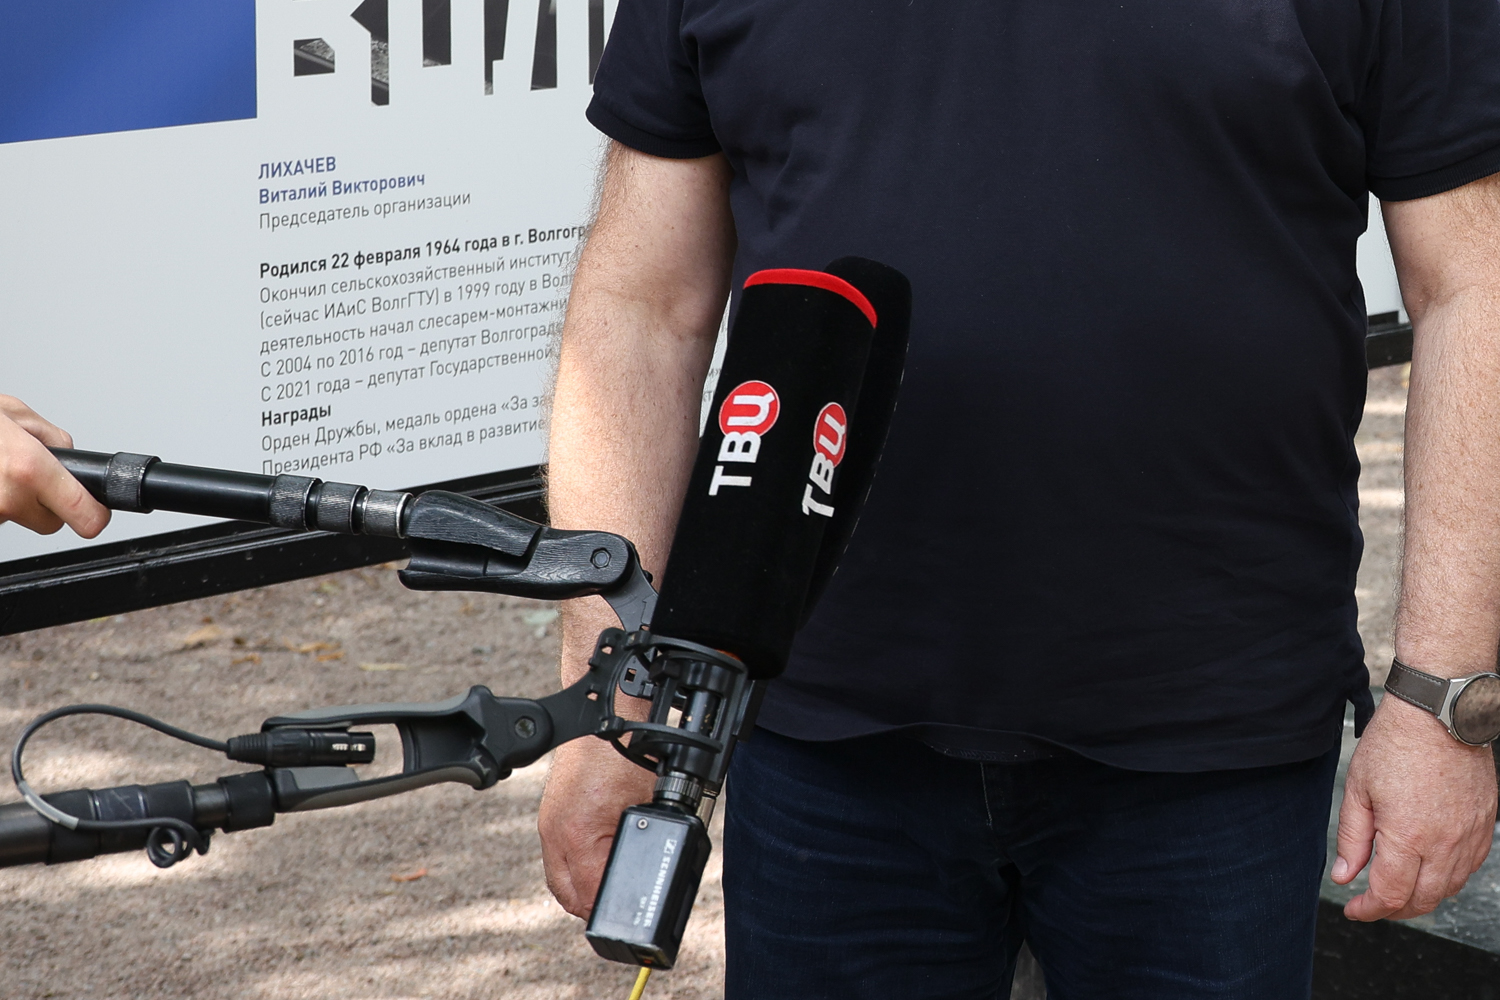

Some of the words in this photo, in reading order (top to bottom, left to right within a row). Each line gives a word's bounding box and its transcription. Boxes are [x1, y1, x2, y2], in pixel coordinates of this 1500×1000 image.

[258, 156, 336, 179] ЛИХАЧЕВ
[259, 180, 328, 205] Виталий
[331, 174, 425, 197] Викторович
[259, 205, 370, 233] Председатель
[373, 193, 471, 219] организации
[259, 258, 327, 280] Родился
[330, 251, 350, 270] 22
[353, 246, 421, 271] февраля
[425, 237, 461, 258] 1964
[464, 236, 498, 254] года
[501, 235, 511, 248] в
[514, 233, 524, 246] г.
[527, 224, 588, 245] Волгогр
[259, 283, 327, 304] Окончил
[330, 255, 505, 295] сельскохозяйственный
[509, 250, 572, 271] институт
[259, 327, 366, 357] деятельность
[369, 319, 414, 338] начал
[418, 298, 568, 331] слесарем-монтажни
[260, 308, 320, 330] (сейчас
[324, 298, 367, 320] ИАиС
[371, 286, 439, 314] ВолгГТУ)
[443, 290, 453, 303] в
[457, 281, 491, 301] 1999
[494, 280, 526, 297] году
[529, 279, 538, 292] в
[260, 360, 272, 378] С
[275, 354, 313, 376] 2004
[316, 355, 335, 370] по
[339, 345, 375, 367] 2016
[378, 345, 404, 362] год
[419, 334, 477, 358] депутат
[260, 385, 272, 403] С
[276, 379, 312, 401] 2021
[316, 377, 351, 395] года
[367, 366, 426, 389] депутат
[429, 343, 552, 378] Государственной
[261, 404, 332, 428] Награды
[261, 432, 311, 455] Орден
[314, 419, 381, 448] Дружбы,
[385, 413, 441, 432] медаль
[444, 403, 497, 426] ордена
[500, 395, 528, 411] «За
[262, 449, 354, 475] Президента
[359, 441, 383, 461] РФ
[386, 437, 415, 454] «За
[418, 431, 463, 451] вклад
[466, 429, 475, 443] в
[643, 855, 671, 928] SENNHEISER
